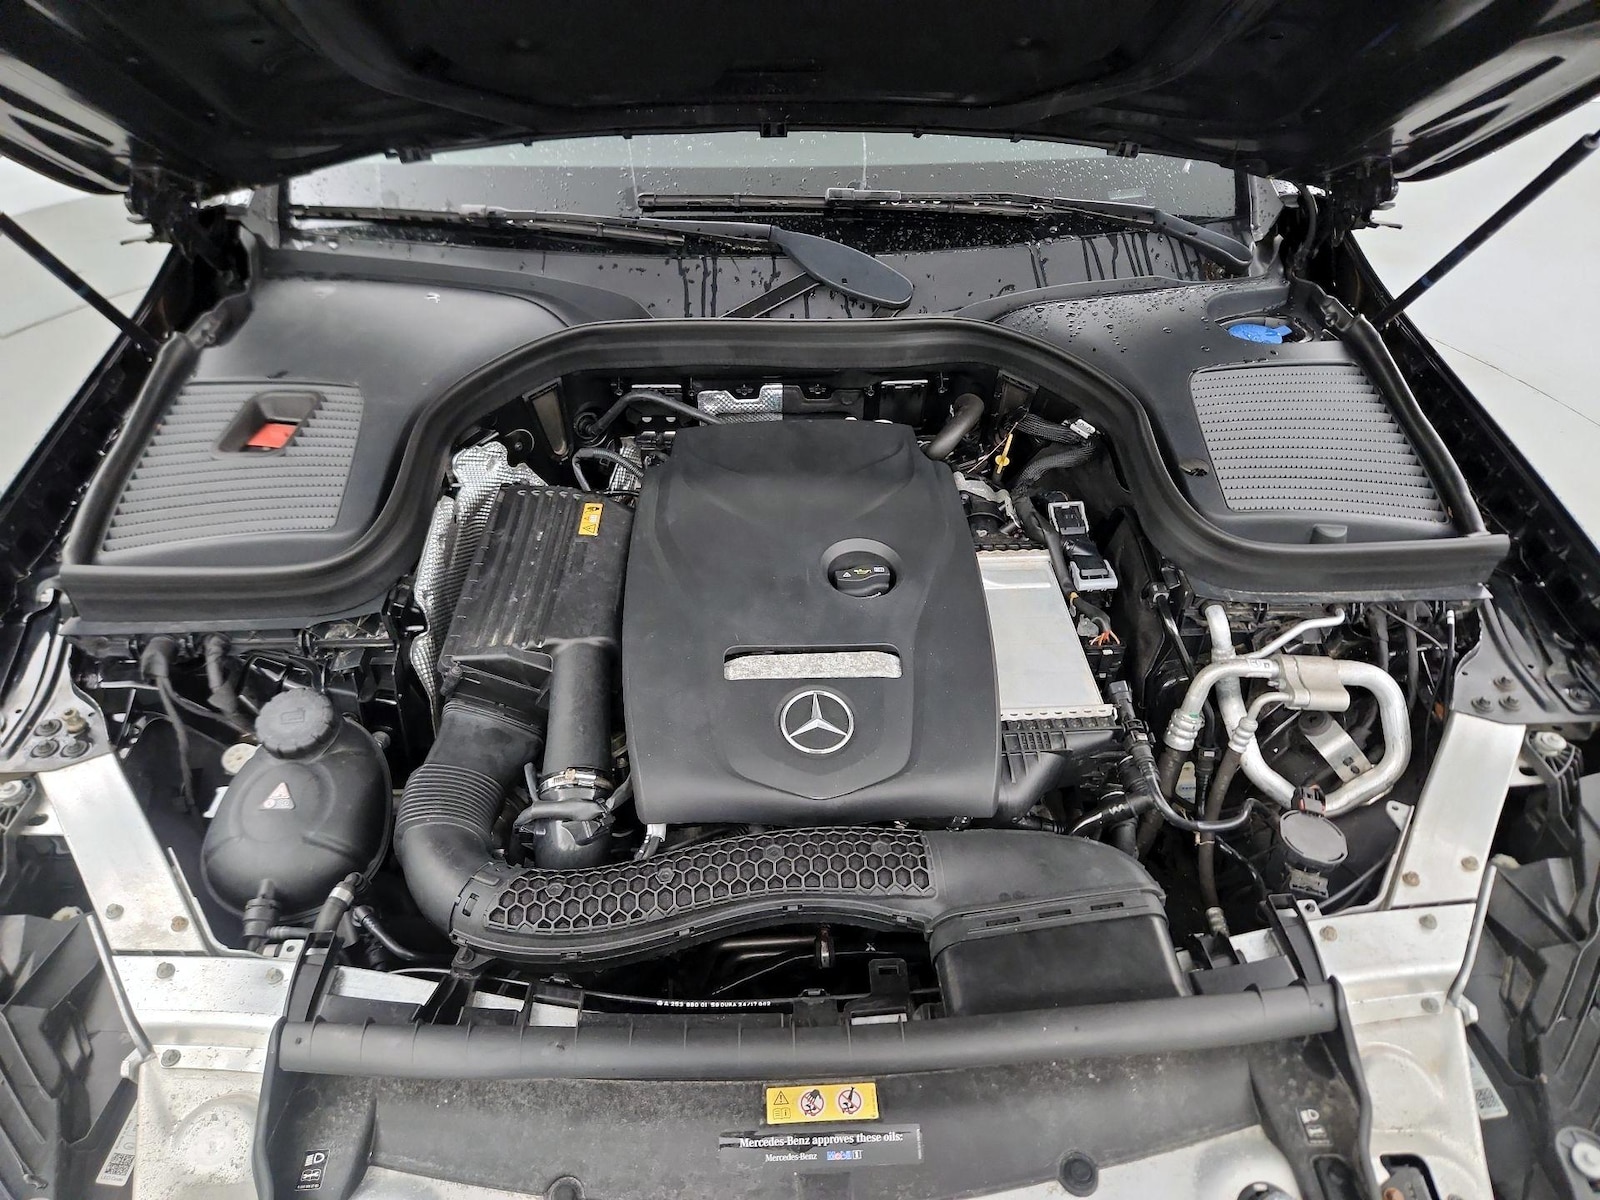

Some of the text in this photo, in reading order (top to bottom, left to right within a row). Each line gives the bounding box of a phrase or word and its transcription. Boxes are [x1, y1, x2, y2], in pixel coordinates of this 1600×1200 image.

[739, 1130, 904, 1149] Mercedes-Benz approves these oils:
[765, 1152, 818, 1163] Mercedes-Benz
